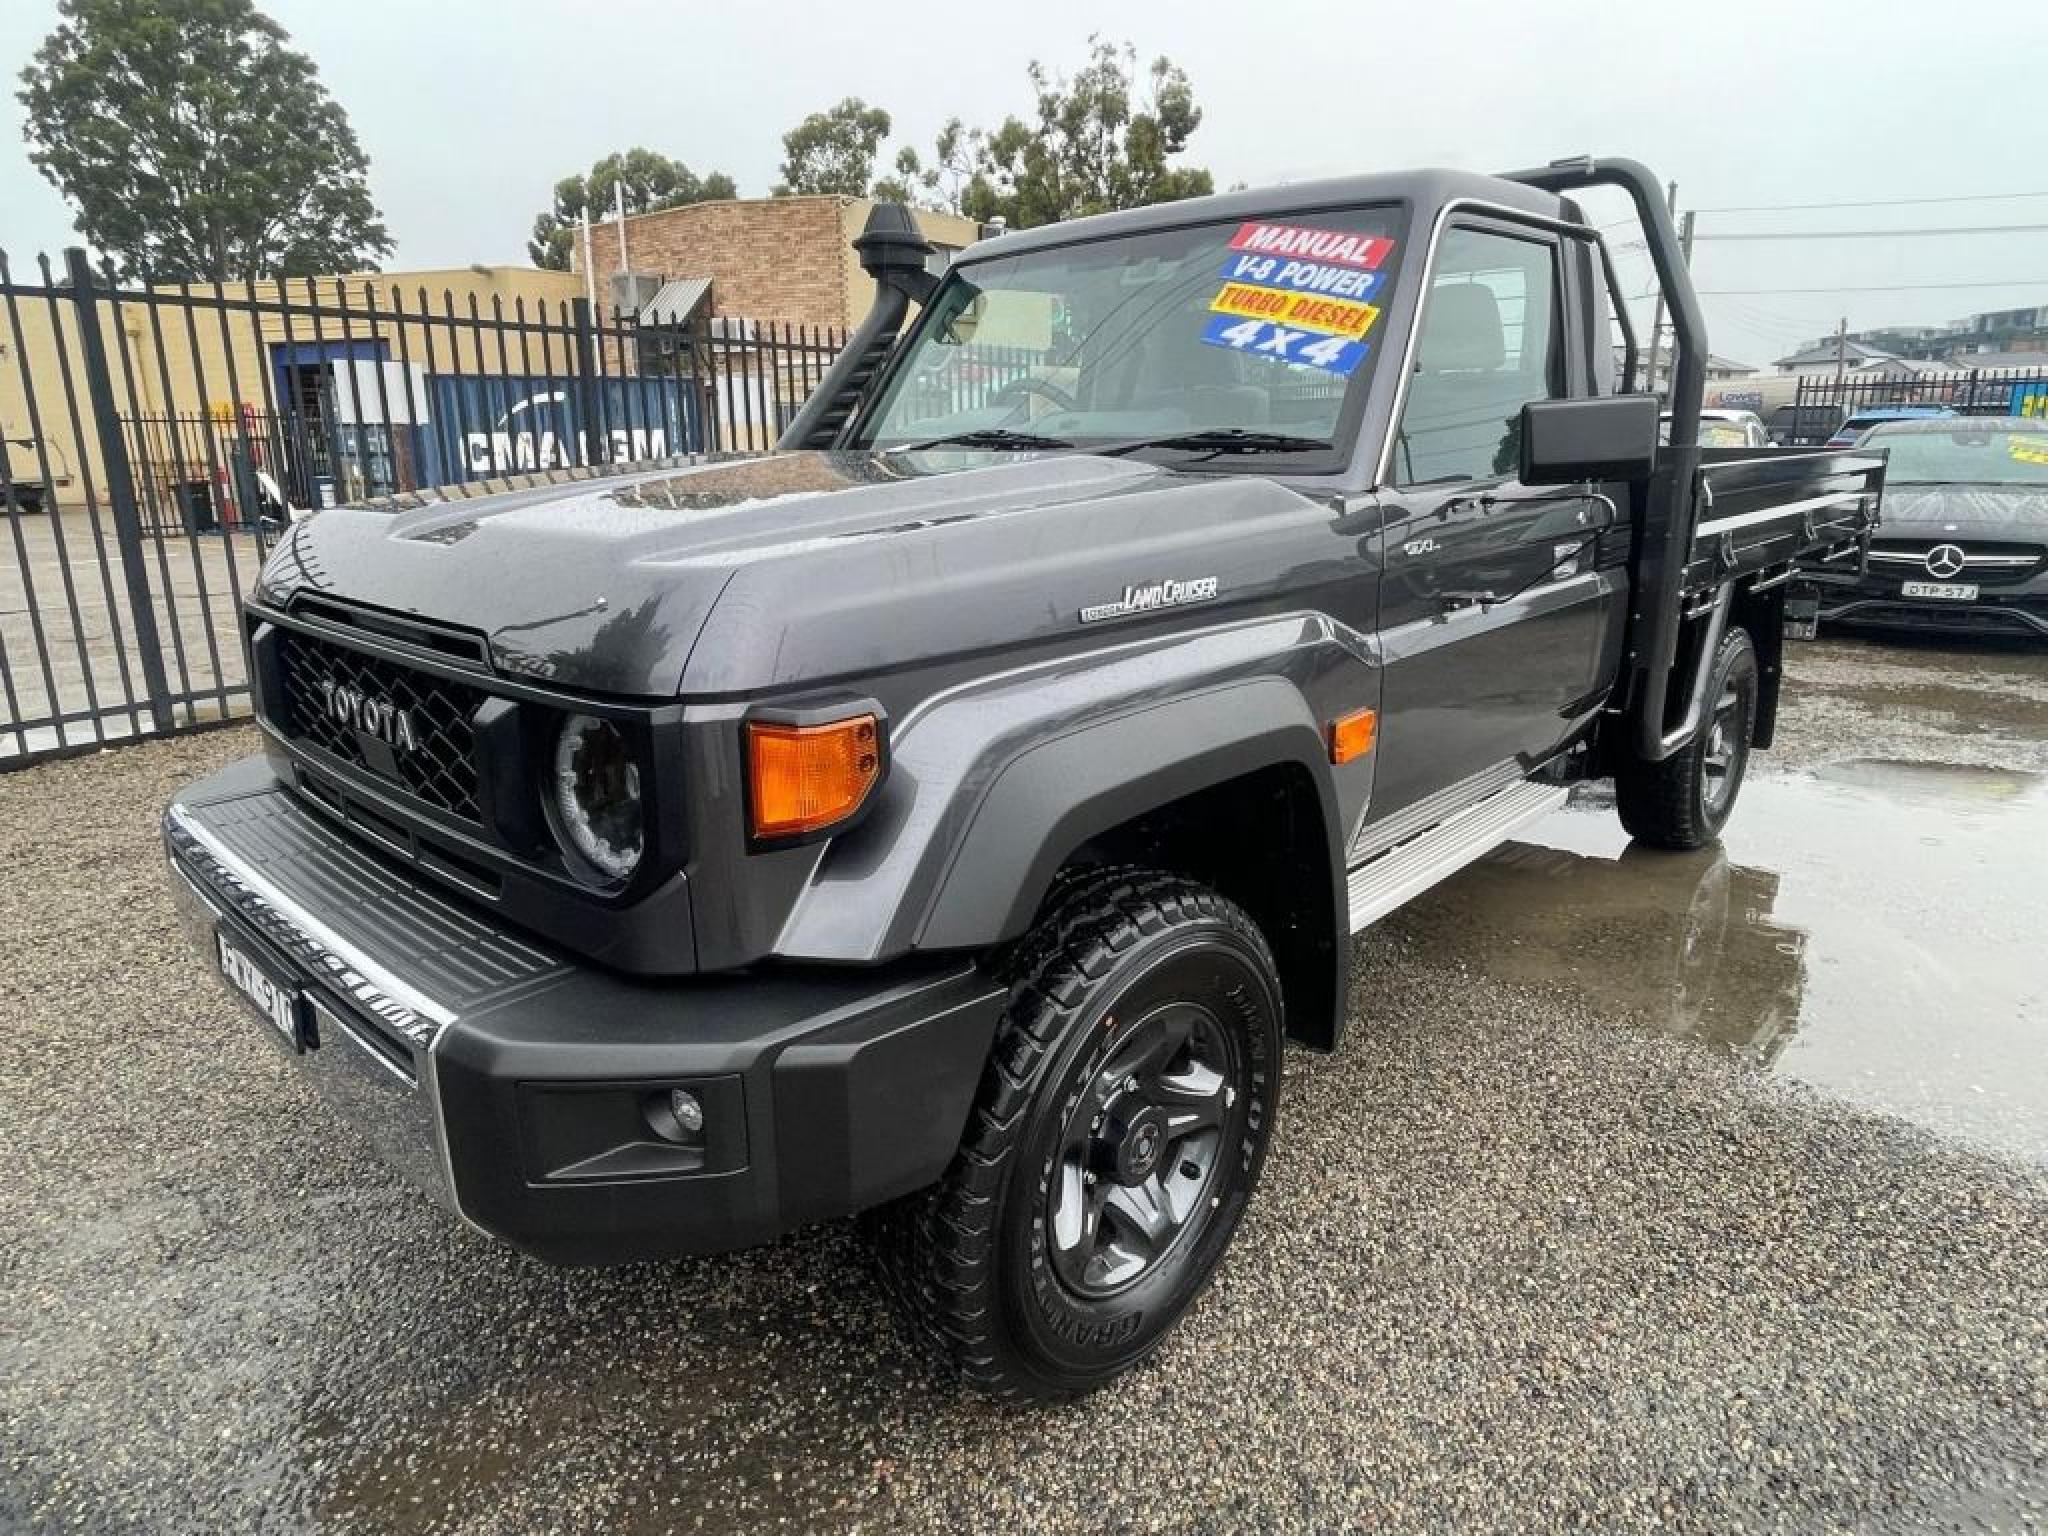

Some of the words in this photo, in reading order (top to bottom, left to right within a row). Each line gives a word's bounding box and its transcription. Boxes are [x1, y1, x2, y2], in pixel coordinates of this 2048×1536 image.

[1243, 224, 1375, 263] MANUAL
[1233, 255, 1277, 281] V-8
[1274, 261, 1375, 297] POWER
[1215, 286, 1290, 317] TURBO
[1287, 298, 1372, 333] DIESEL
[321, 680, 417, 752] TOYOTA
